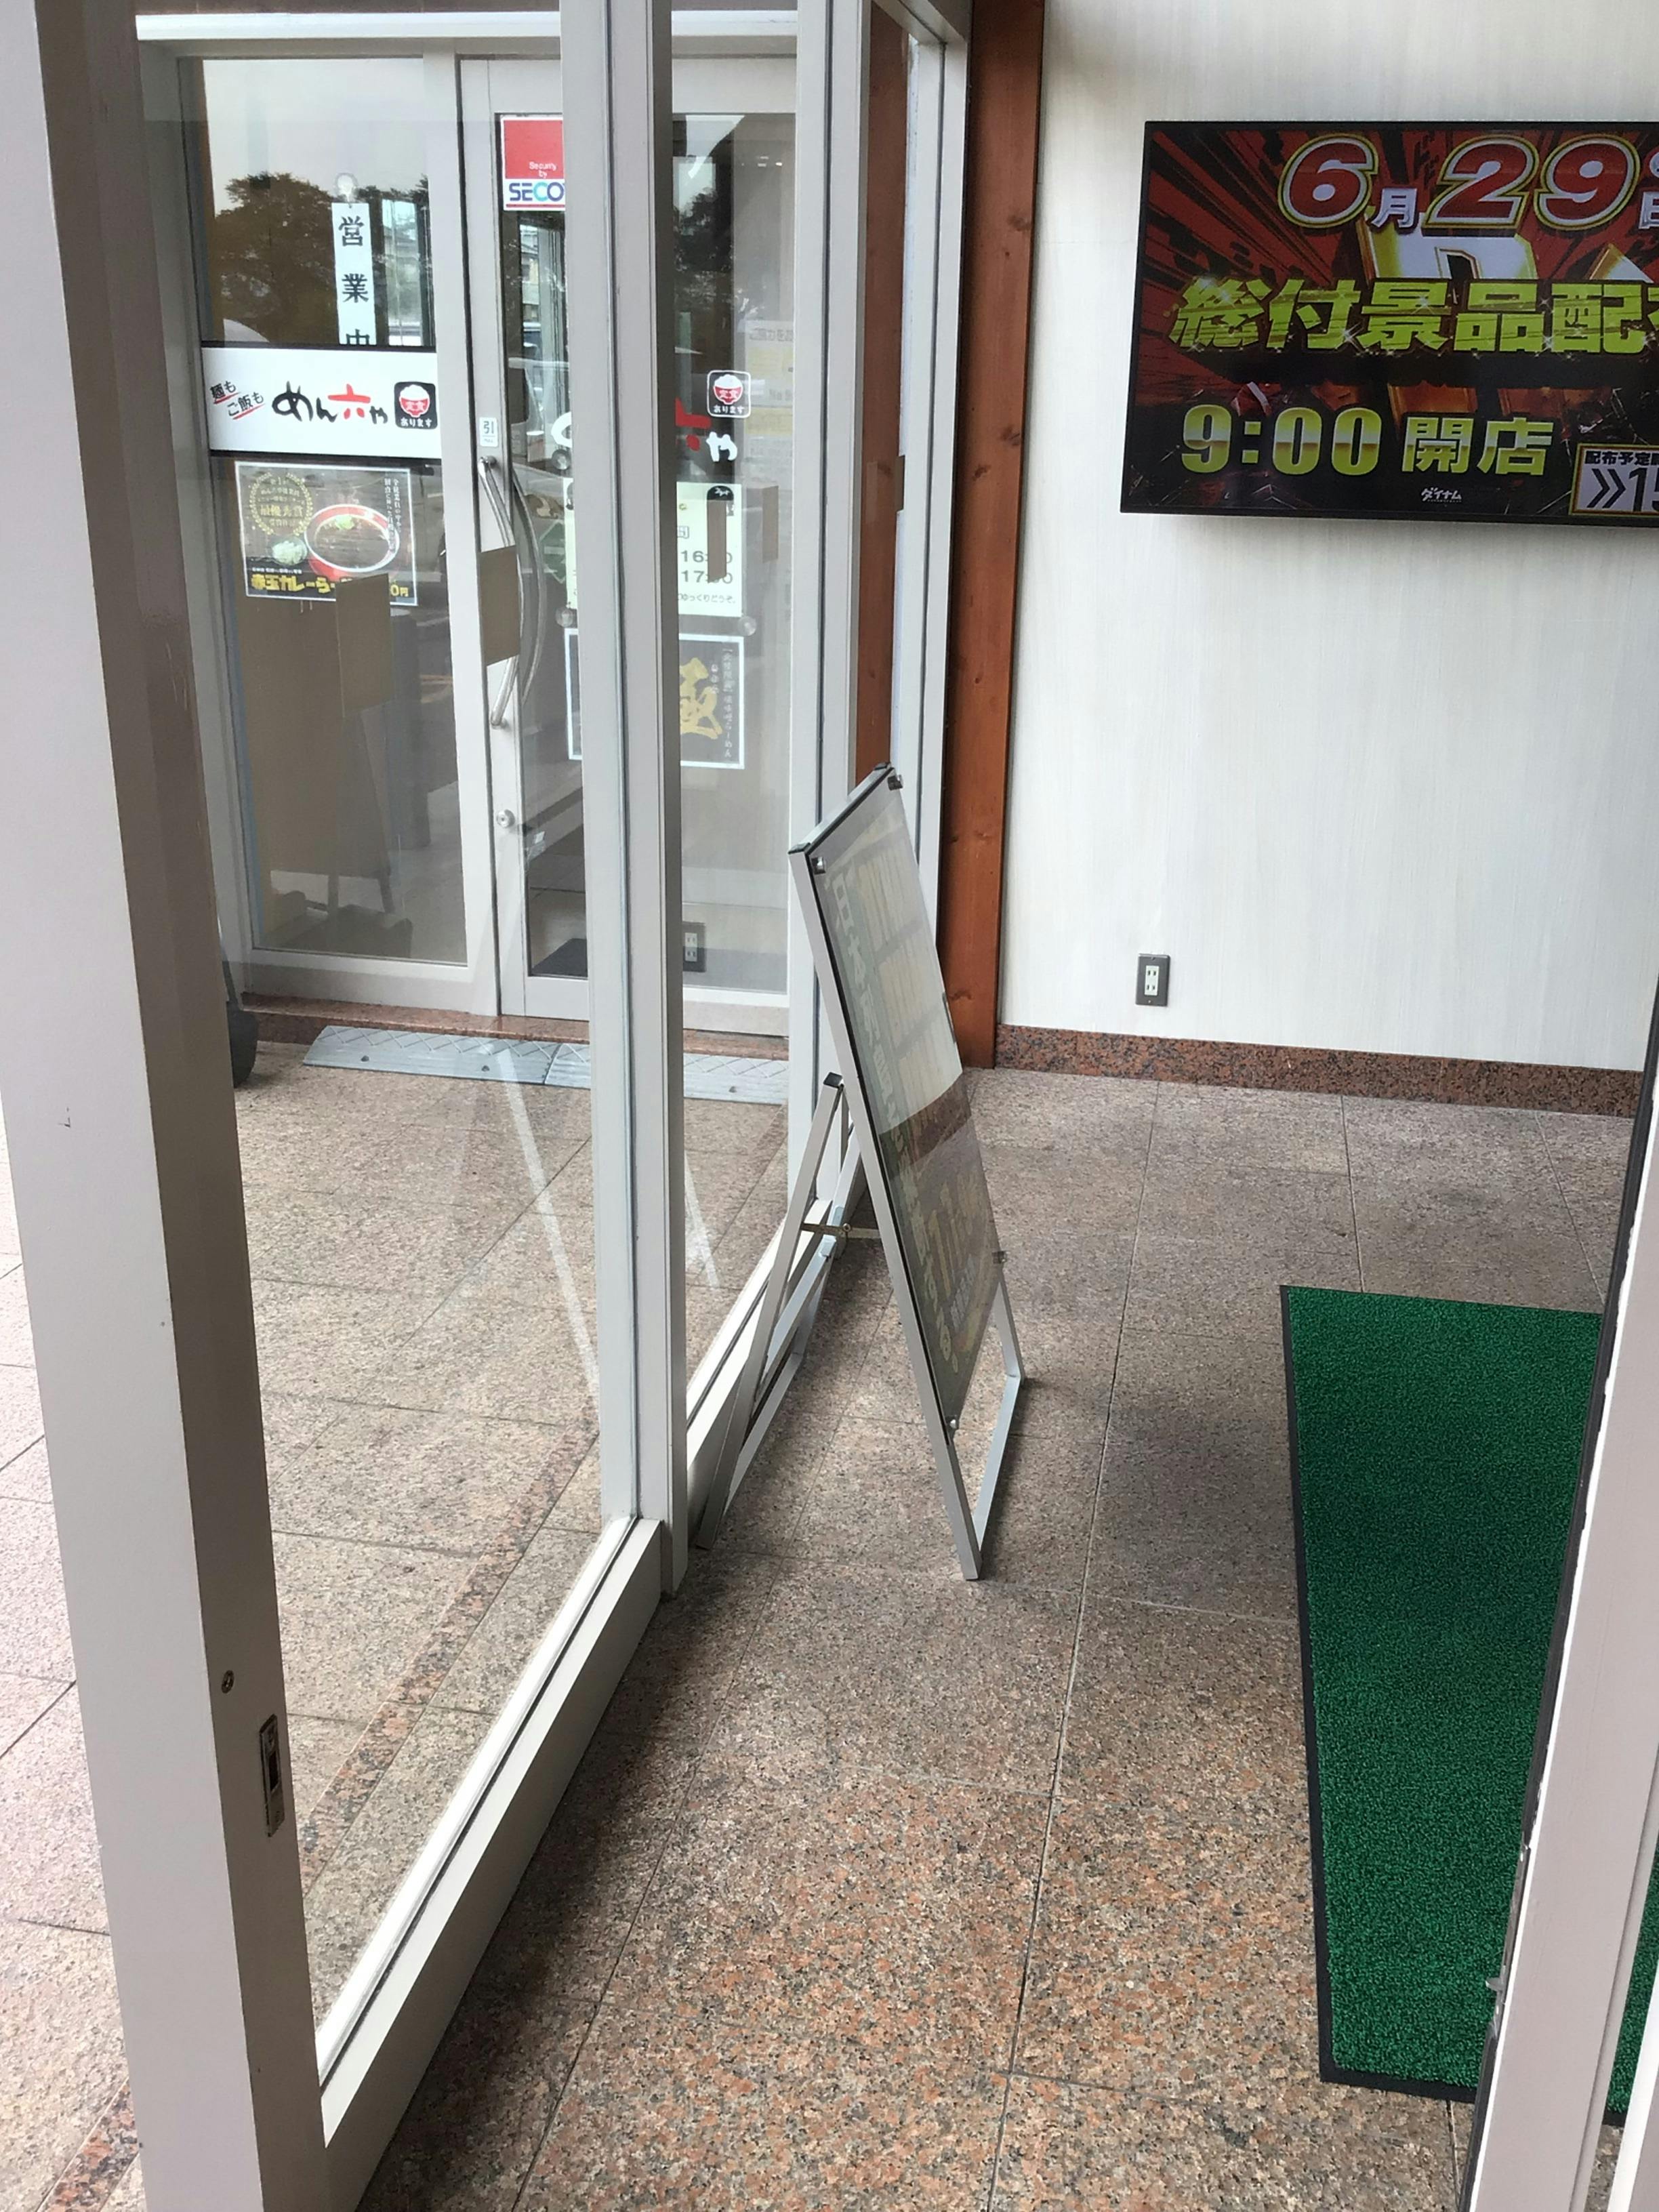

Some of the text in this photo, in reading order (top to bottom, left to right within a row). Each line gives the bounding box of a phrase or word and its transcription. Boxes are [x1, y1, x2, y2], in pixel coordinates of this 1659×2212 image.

[509, 182, 565, 202] SECO
[1168, 276, 1659, 355] 総付景品配
[227, 392, 264, 417] ご飯も
[272, 381, 388, 424] めん六や
[714, 405, 745, 415] あります
[401, 417, 432, 428] あります
[483, 420, 494, 434] 引
[1181, 405, 1553, 476] 9:00 開店
[1421, 487, 1462, 501] ダイナム
